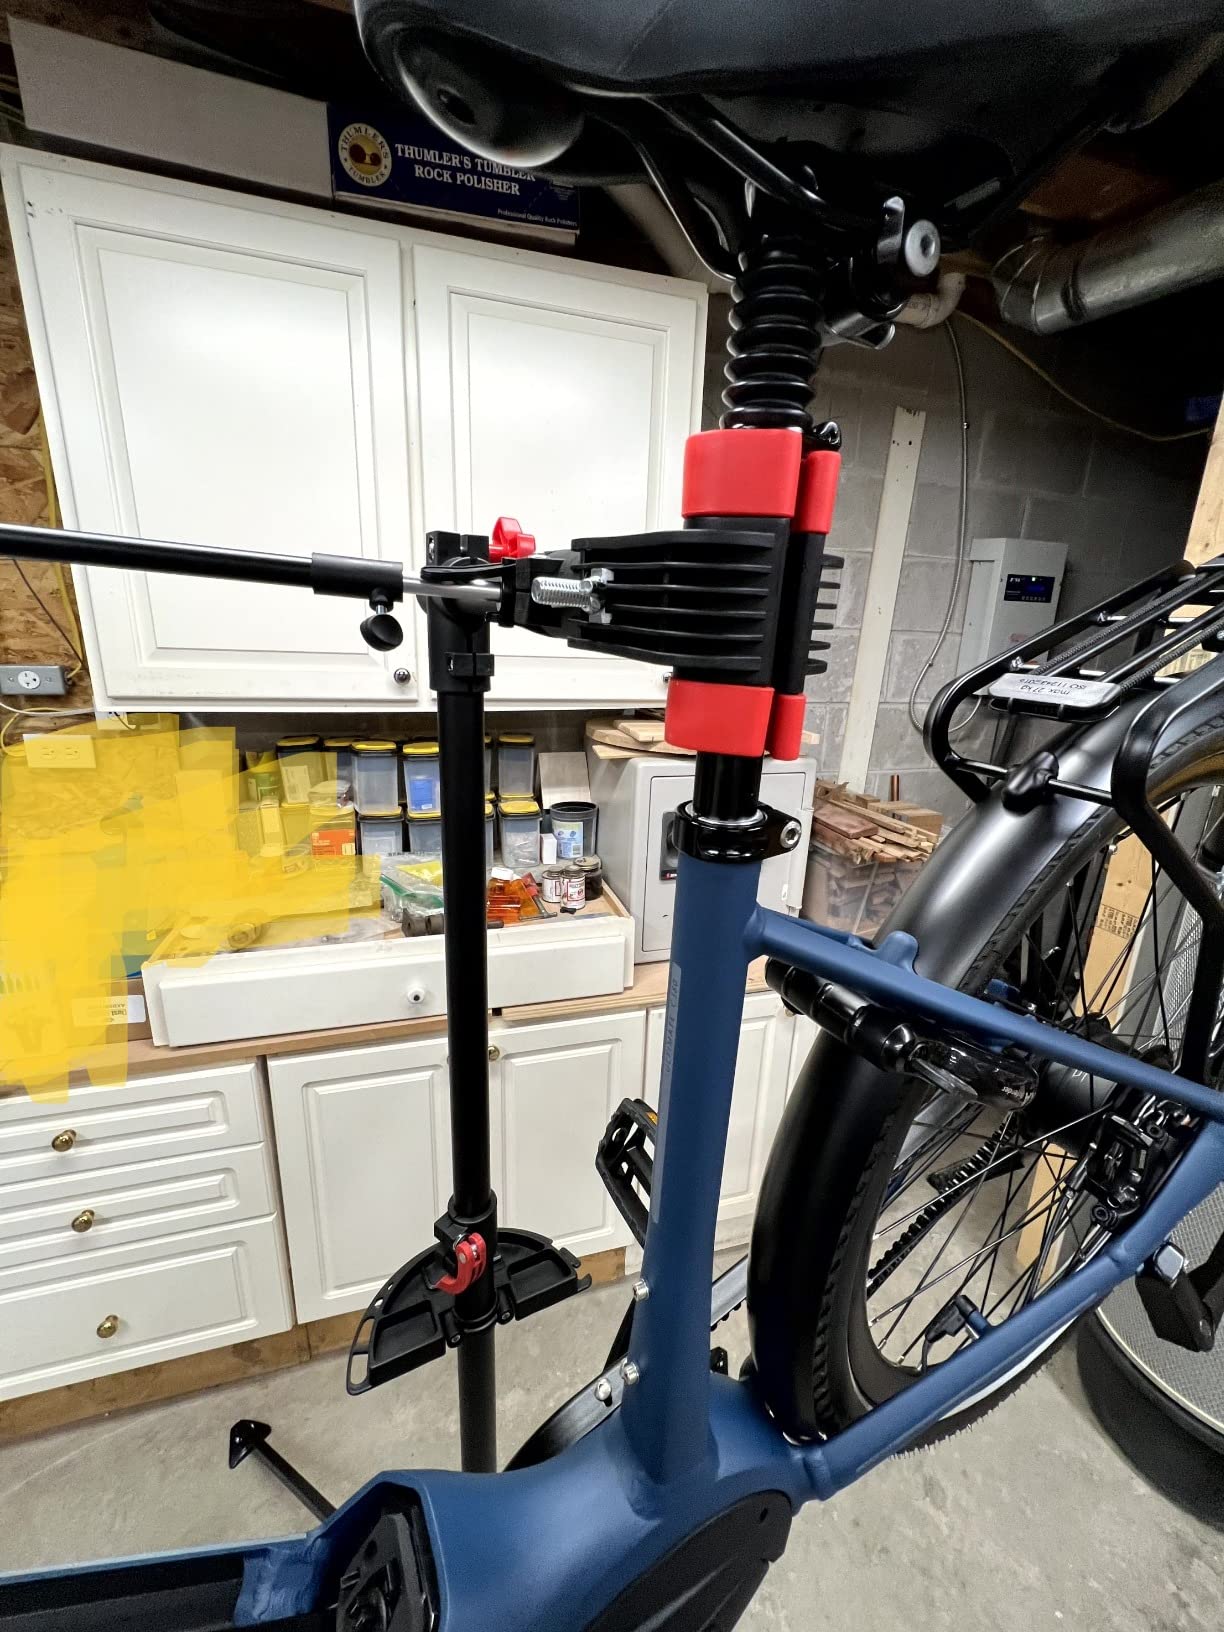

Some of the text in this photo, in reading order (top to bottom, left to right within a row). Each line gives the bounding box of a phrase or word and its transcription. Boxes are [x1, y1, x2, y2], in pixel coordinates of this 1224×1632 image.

[395, 143, 472, 169] THUMLER'S
[414, 164, 520, 196] ROCK POLISHER
[497, 207, 526, 220] Professional
[526, 212, 544, 223] Quality
